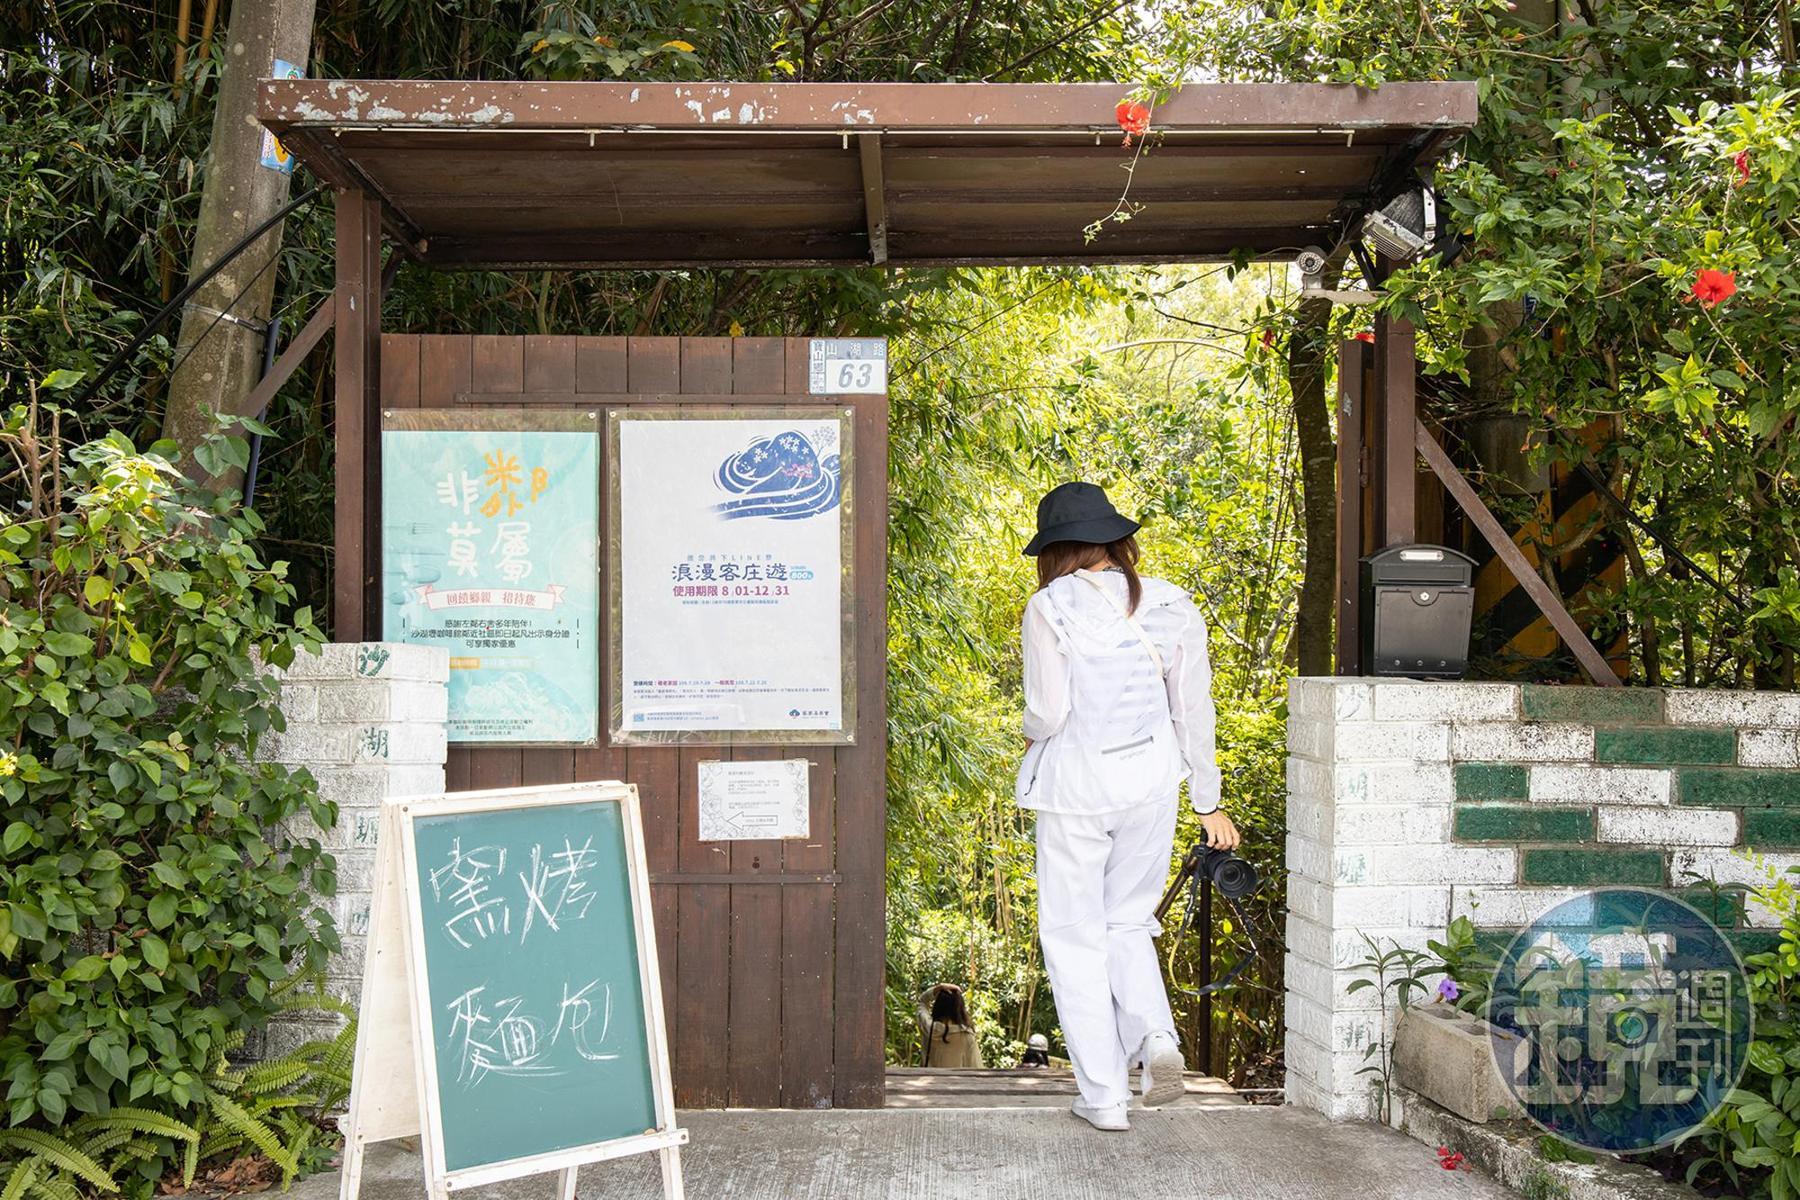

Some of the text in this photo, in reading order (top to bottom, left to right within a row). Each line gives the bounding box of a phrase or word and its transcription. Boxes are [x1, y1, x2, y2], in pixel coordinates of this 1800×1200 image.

[838, 362, 873, 389] 63
[671, 562, 788, 582] 浪漫客庄遊
[673, 585, 718, 597] 使用期限
[428, 835, 598, 949] 窯烤
[447, 978, 622, 1092] 麵包
